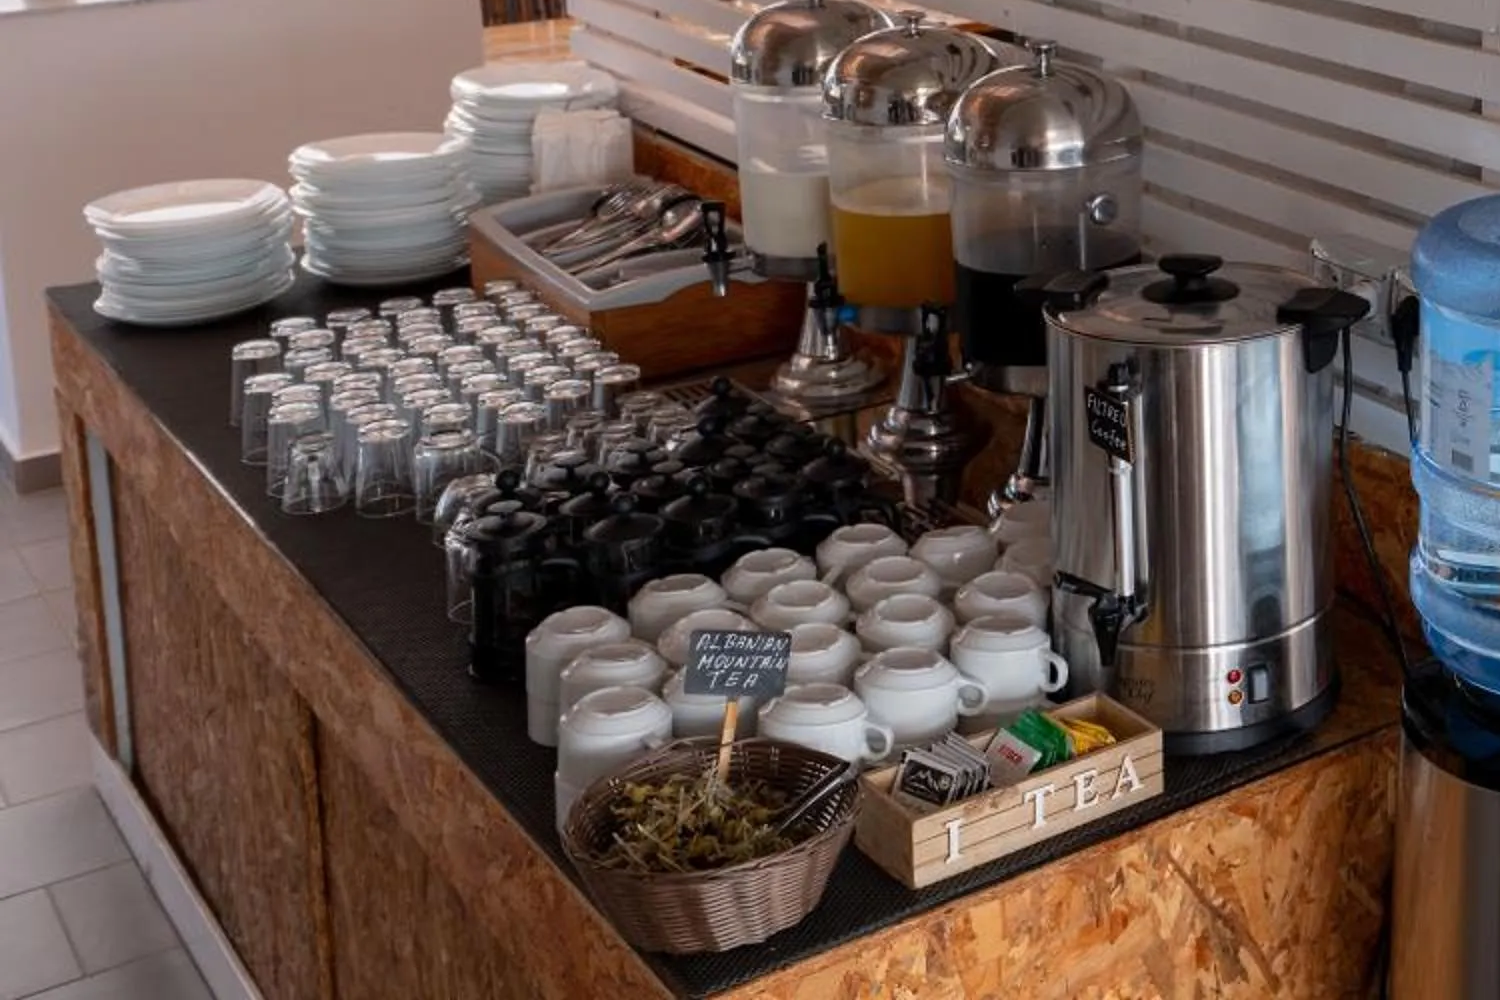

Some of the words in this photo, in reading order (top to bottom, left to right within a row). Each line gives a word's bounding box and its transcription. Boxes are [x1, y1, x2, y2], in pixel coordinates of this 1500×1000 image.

[696, 632, 789, 651] ALBANIAN
[697, 651, 787, 671] MOUNTAIN
[706, 669, 759, 690] TEA
[1022, 752, 1144, 830] TEA
